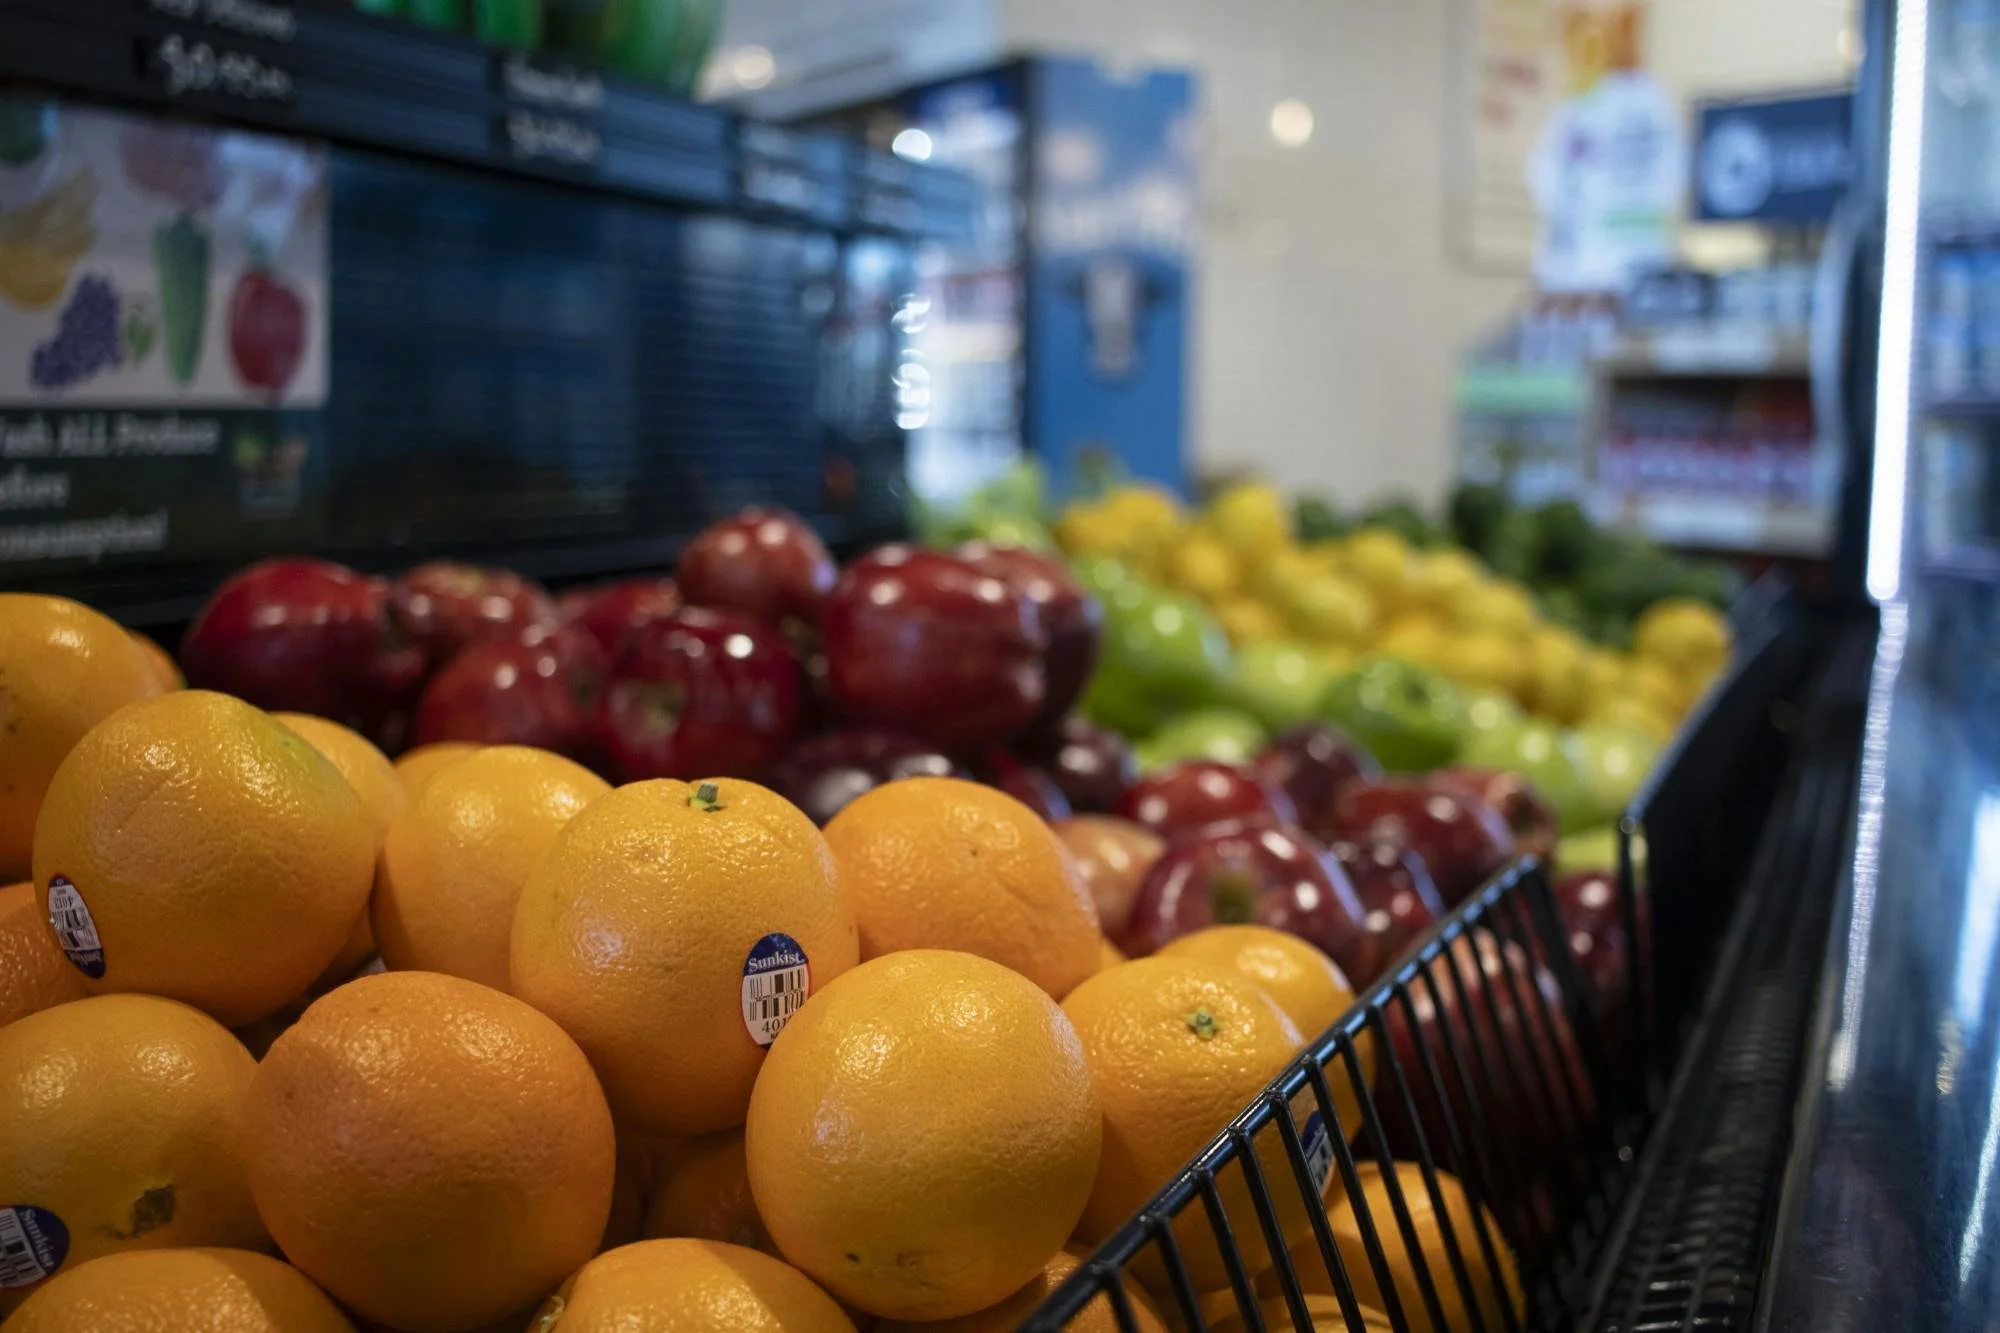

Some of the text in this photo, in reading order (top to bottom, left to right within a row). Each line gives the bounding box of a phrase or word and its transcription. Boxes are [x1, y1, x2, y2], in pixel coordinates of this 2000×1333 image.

[0, 412, 52, 457] ash
[57, 412, 107, 456] ALL
[0, 463, 69, 508] efore
[748, 950, 806, 970] Sunkist
[761, 1015, 791, 1033] 401
[21, 1208, 56, 1267] Sunkist
